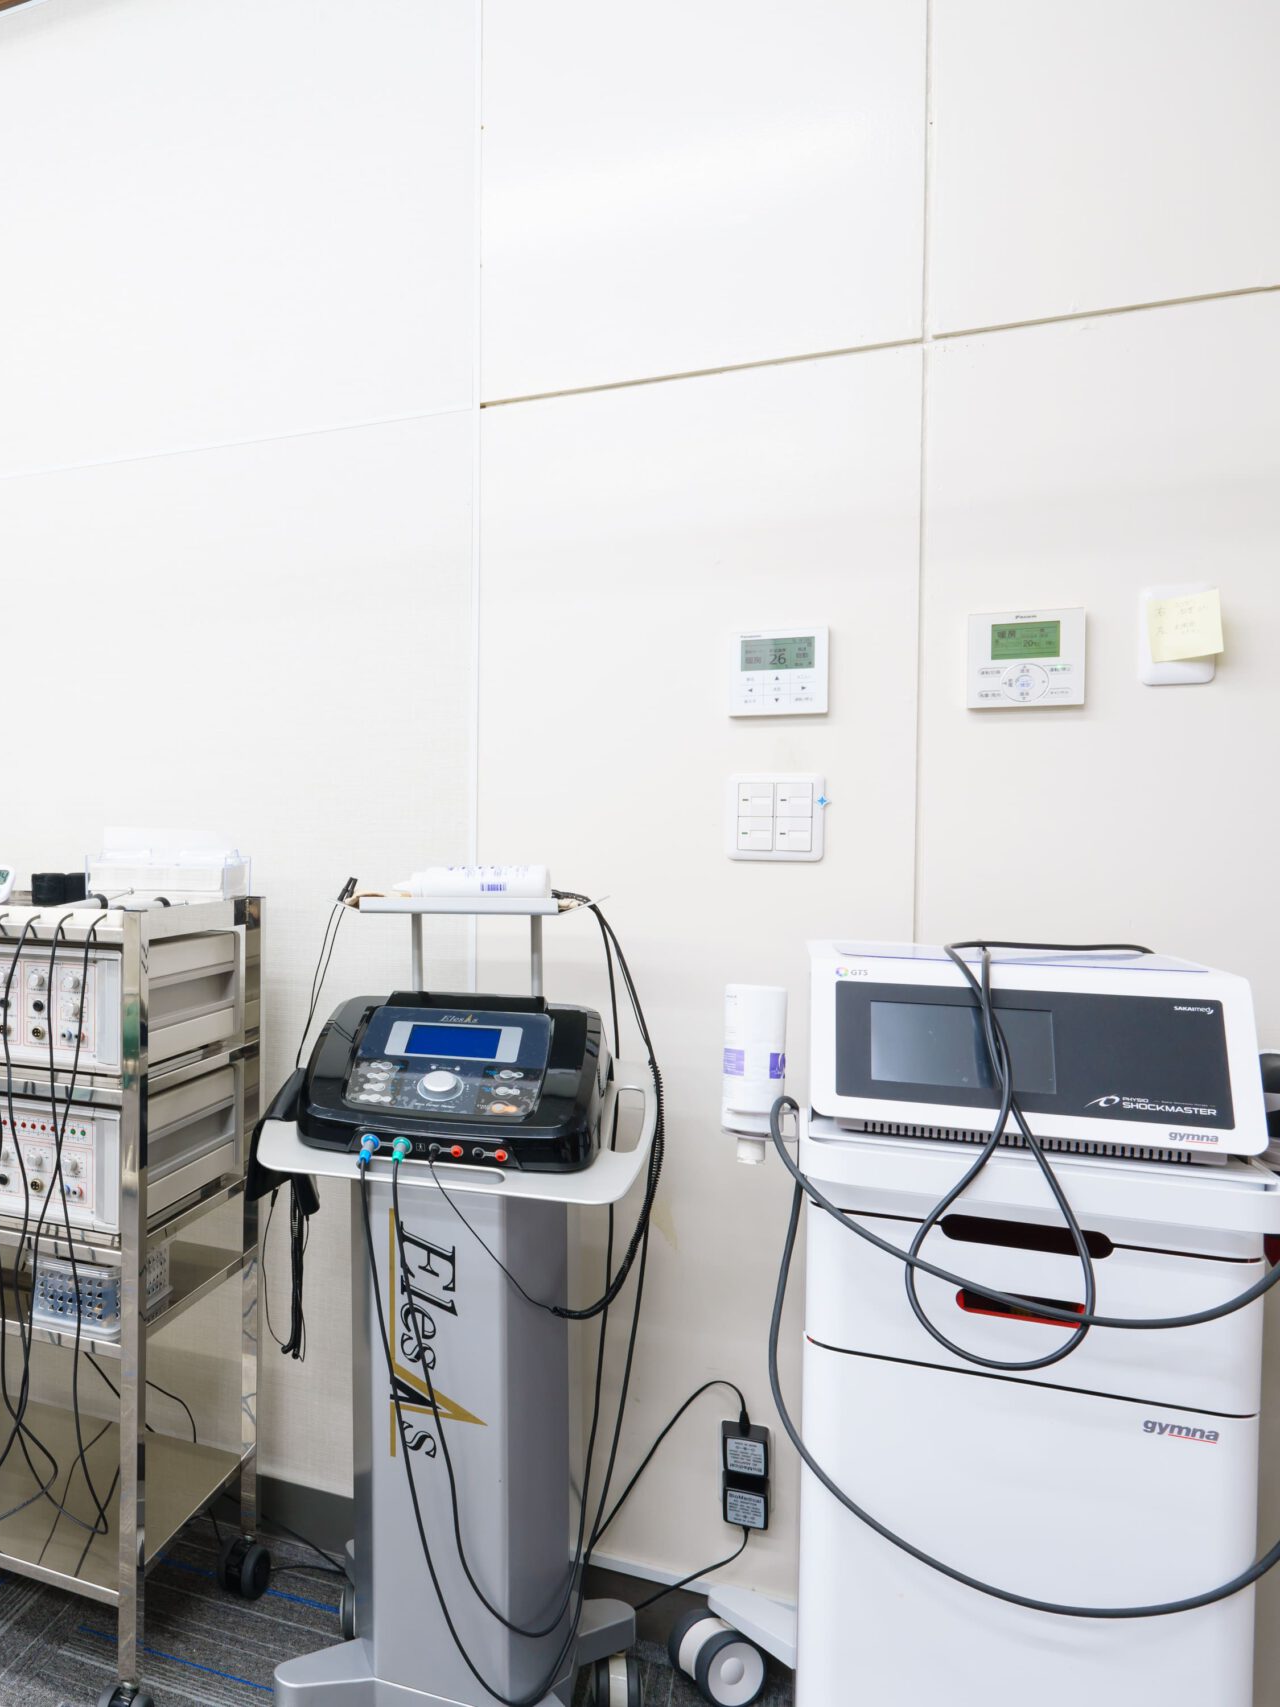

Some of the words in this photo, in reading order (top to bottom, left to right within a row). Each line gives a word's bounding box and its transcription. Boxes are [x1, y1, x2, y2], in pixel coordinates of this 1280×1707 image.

[769, 653, 787, 665] 26
[1122, 1101, 1217, 1117] SHOCKMASTER
[1169, 1131, 1219, 1144] gymna
[1143, 1419, 1220, 1442] gymna
